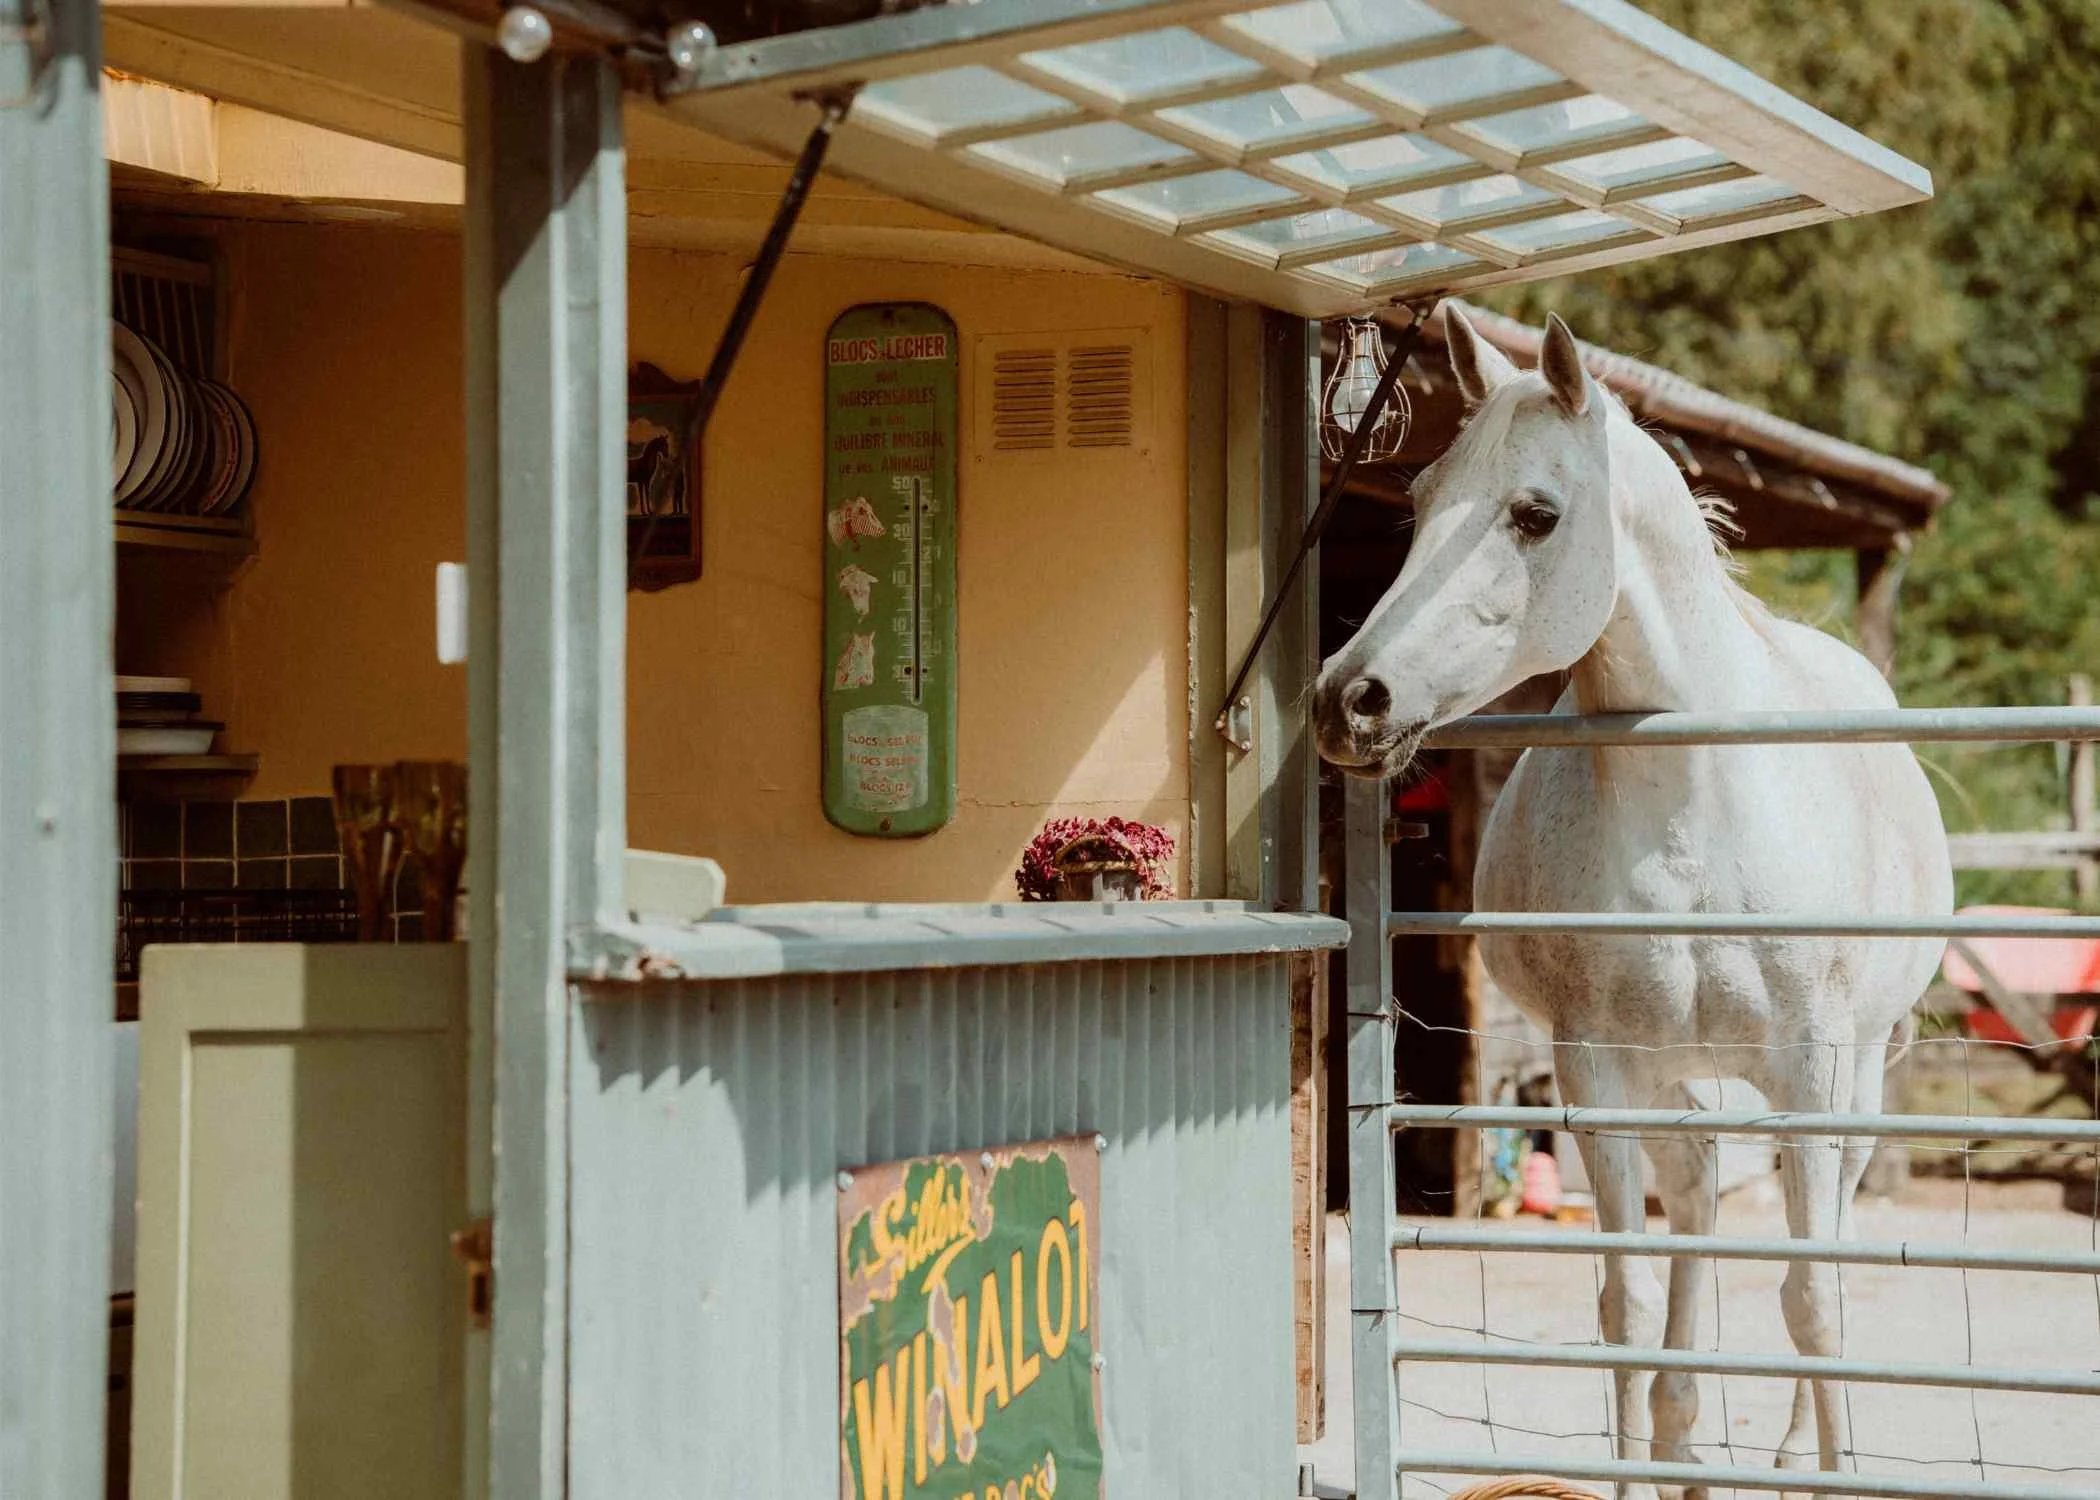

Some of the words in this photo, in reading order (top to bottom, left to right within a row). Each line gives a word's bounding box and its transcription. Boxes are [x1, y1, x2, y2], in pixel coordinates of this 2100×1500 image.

[830, 339, 877, 362] BLOCS
[886, 335, 945, 360] LECHER
[892, 475, 910, 490] 50
[892, 523, 911, 538] 30
